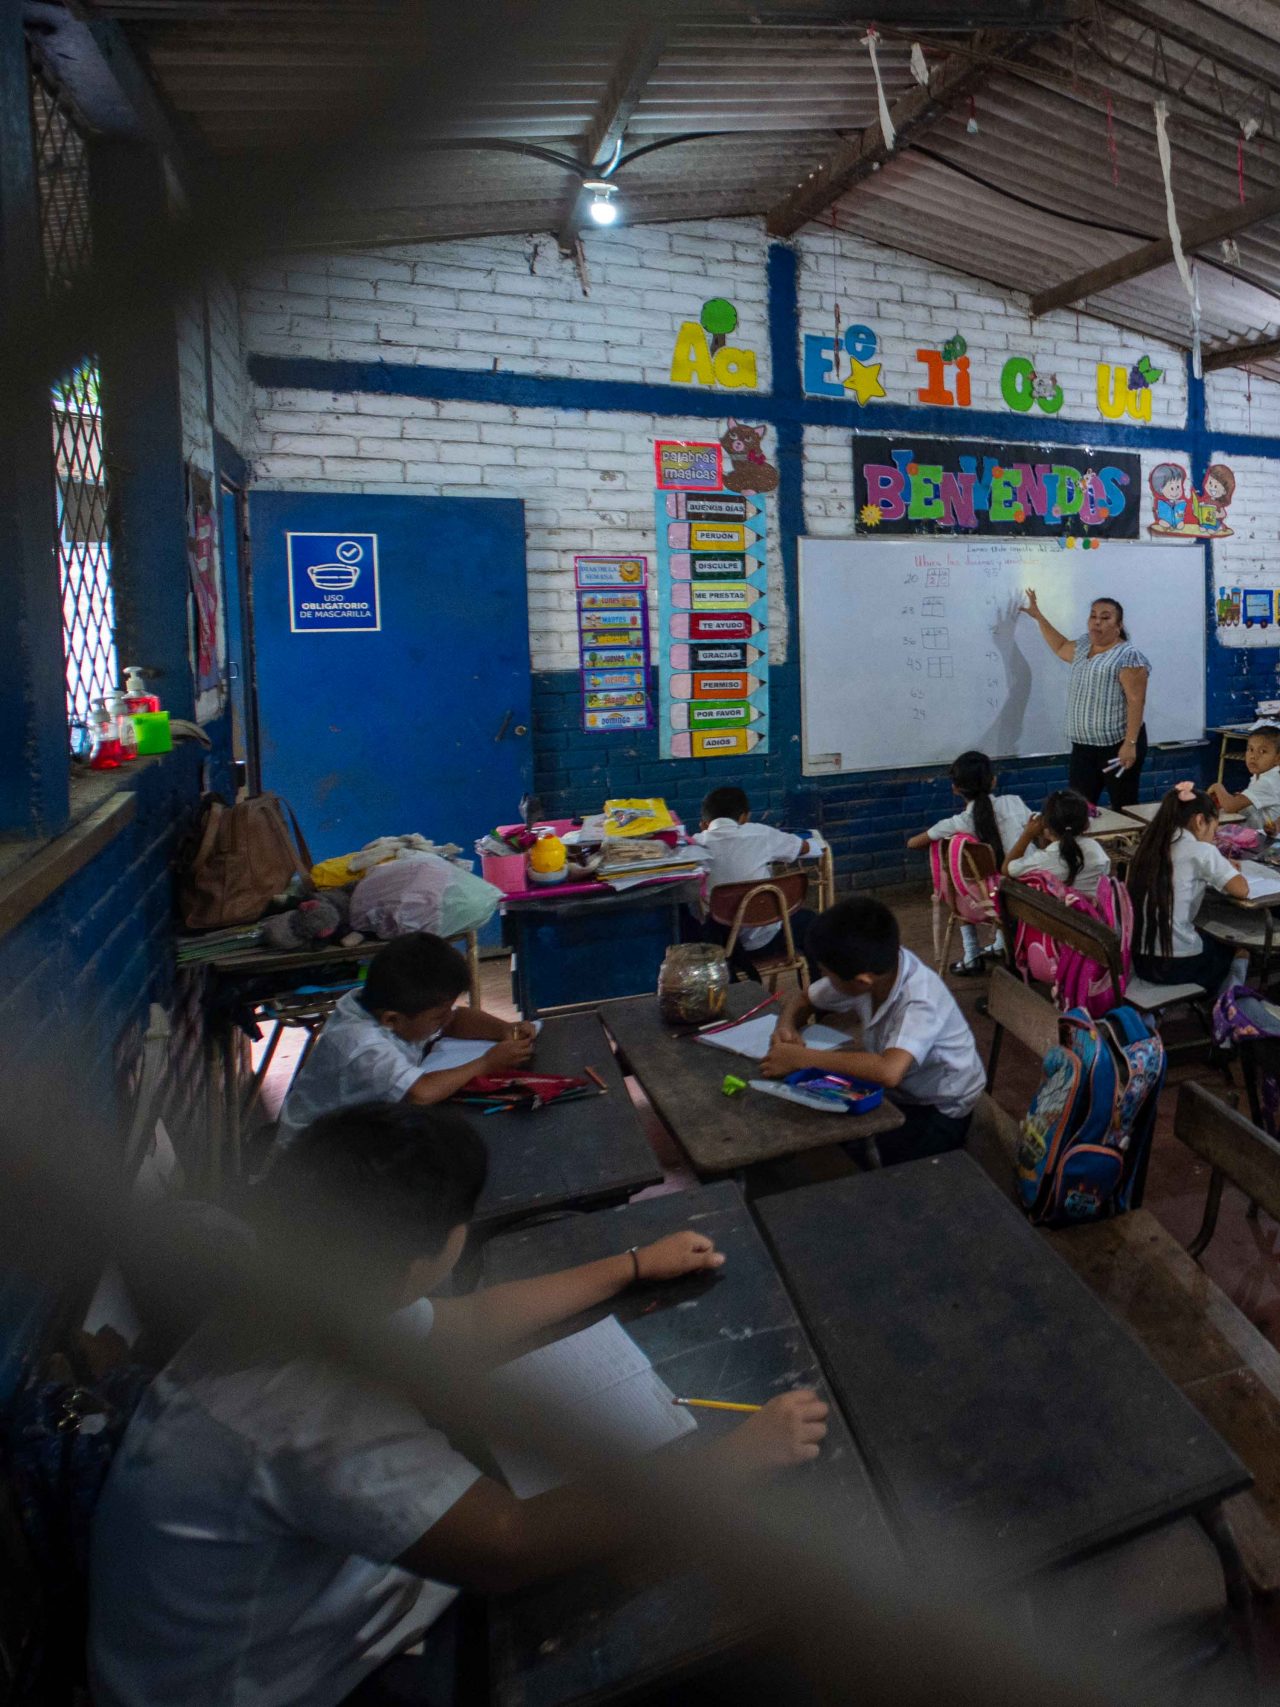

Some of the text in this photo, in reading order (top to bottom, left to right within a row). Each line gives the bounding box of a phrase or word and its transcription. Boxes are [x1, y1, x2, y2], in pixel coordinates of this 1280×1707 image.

[661, 449, 717, 464] palabras
[689, 503, 723, 512] BUENOS
[698, 561, 739, 569] DISCULPE
[903, 572, 919, 584] 20
[324, 594, 344, 602] USO
[301, 602, 369, 610] OBLIGATORIO
[300, 610, 372, 618] DE MASCARILLA
